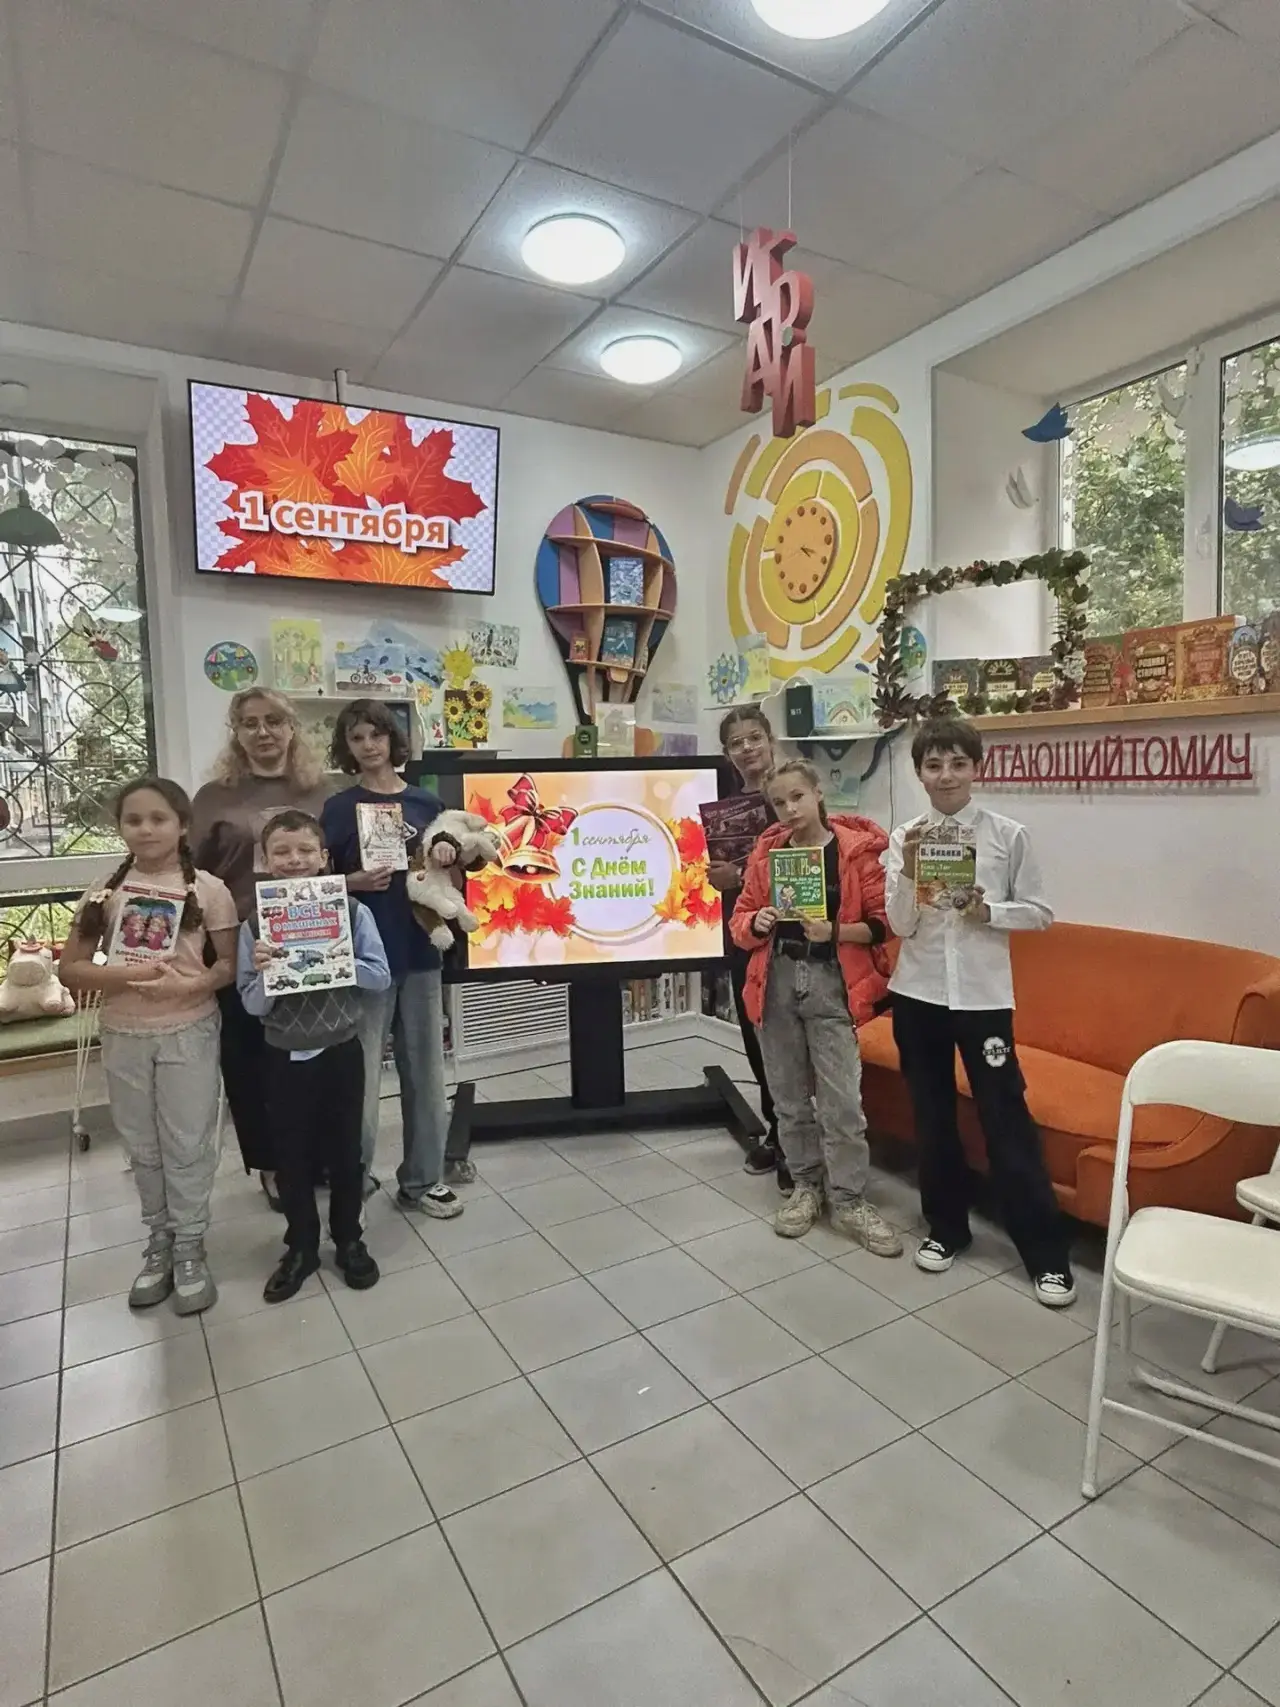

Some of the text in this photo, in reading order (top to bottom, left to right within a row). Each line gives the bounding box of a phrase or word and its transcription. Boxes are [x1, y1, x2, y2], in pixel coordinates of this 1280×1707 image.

[243, 495, 446, 549] 1 сентября
[979, 732, 1251, 789] ИТАЮЩИЙТОМИЧ
[570, 826, 652, 853] 1 сентября
[571, 855, 648, 880] С Днём
[568, 877, 655, 900] Знаний!
